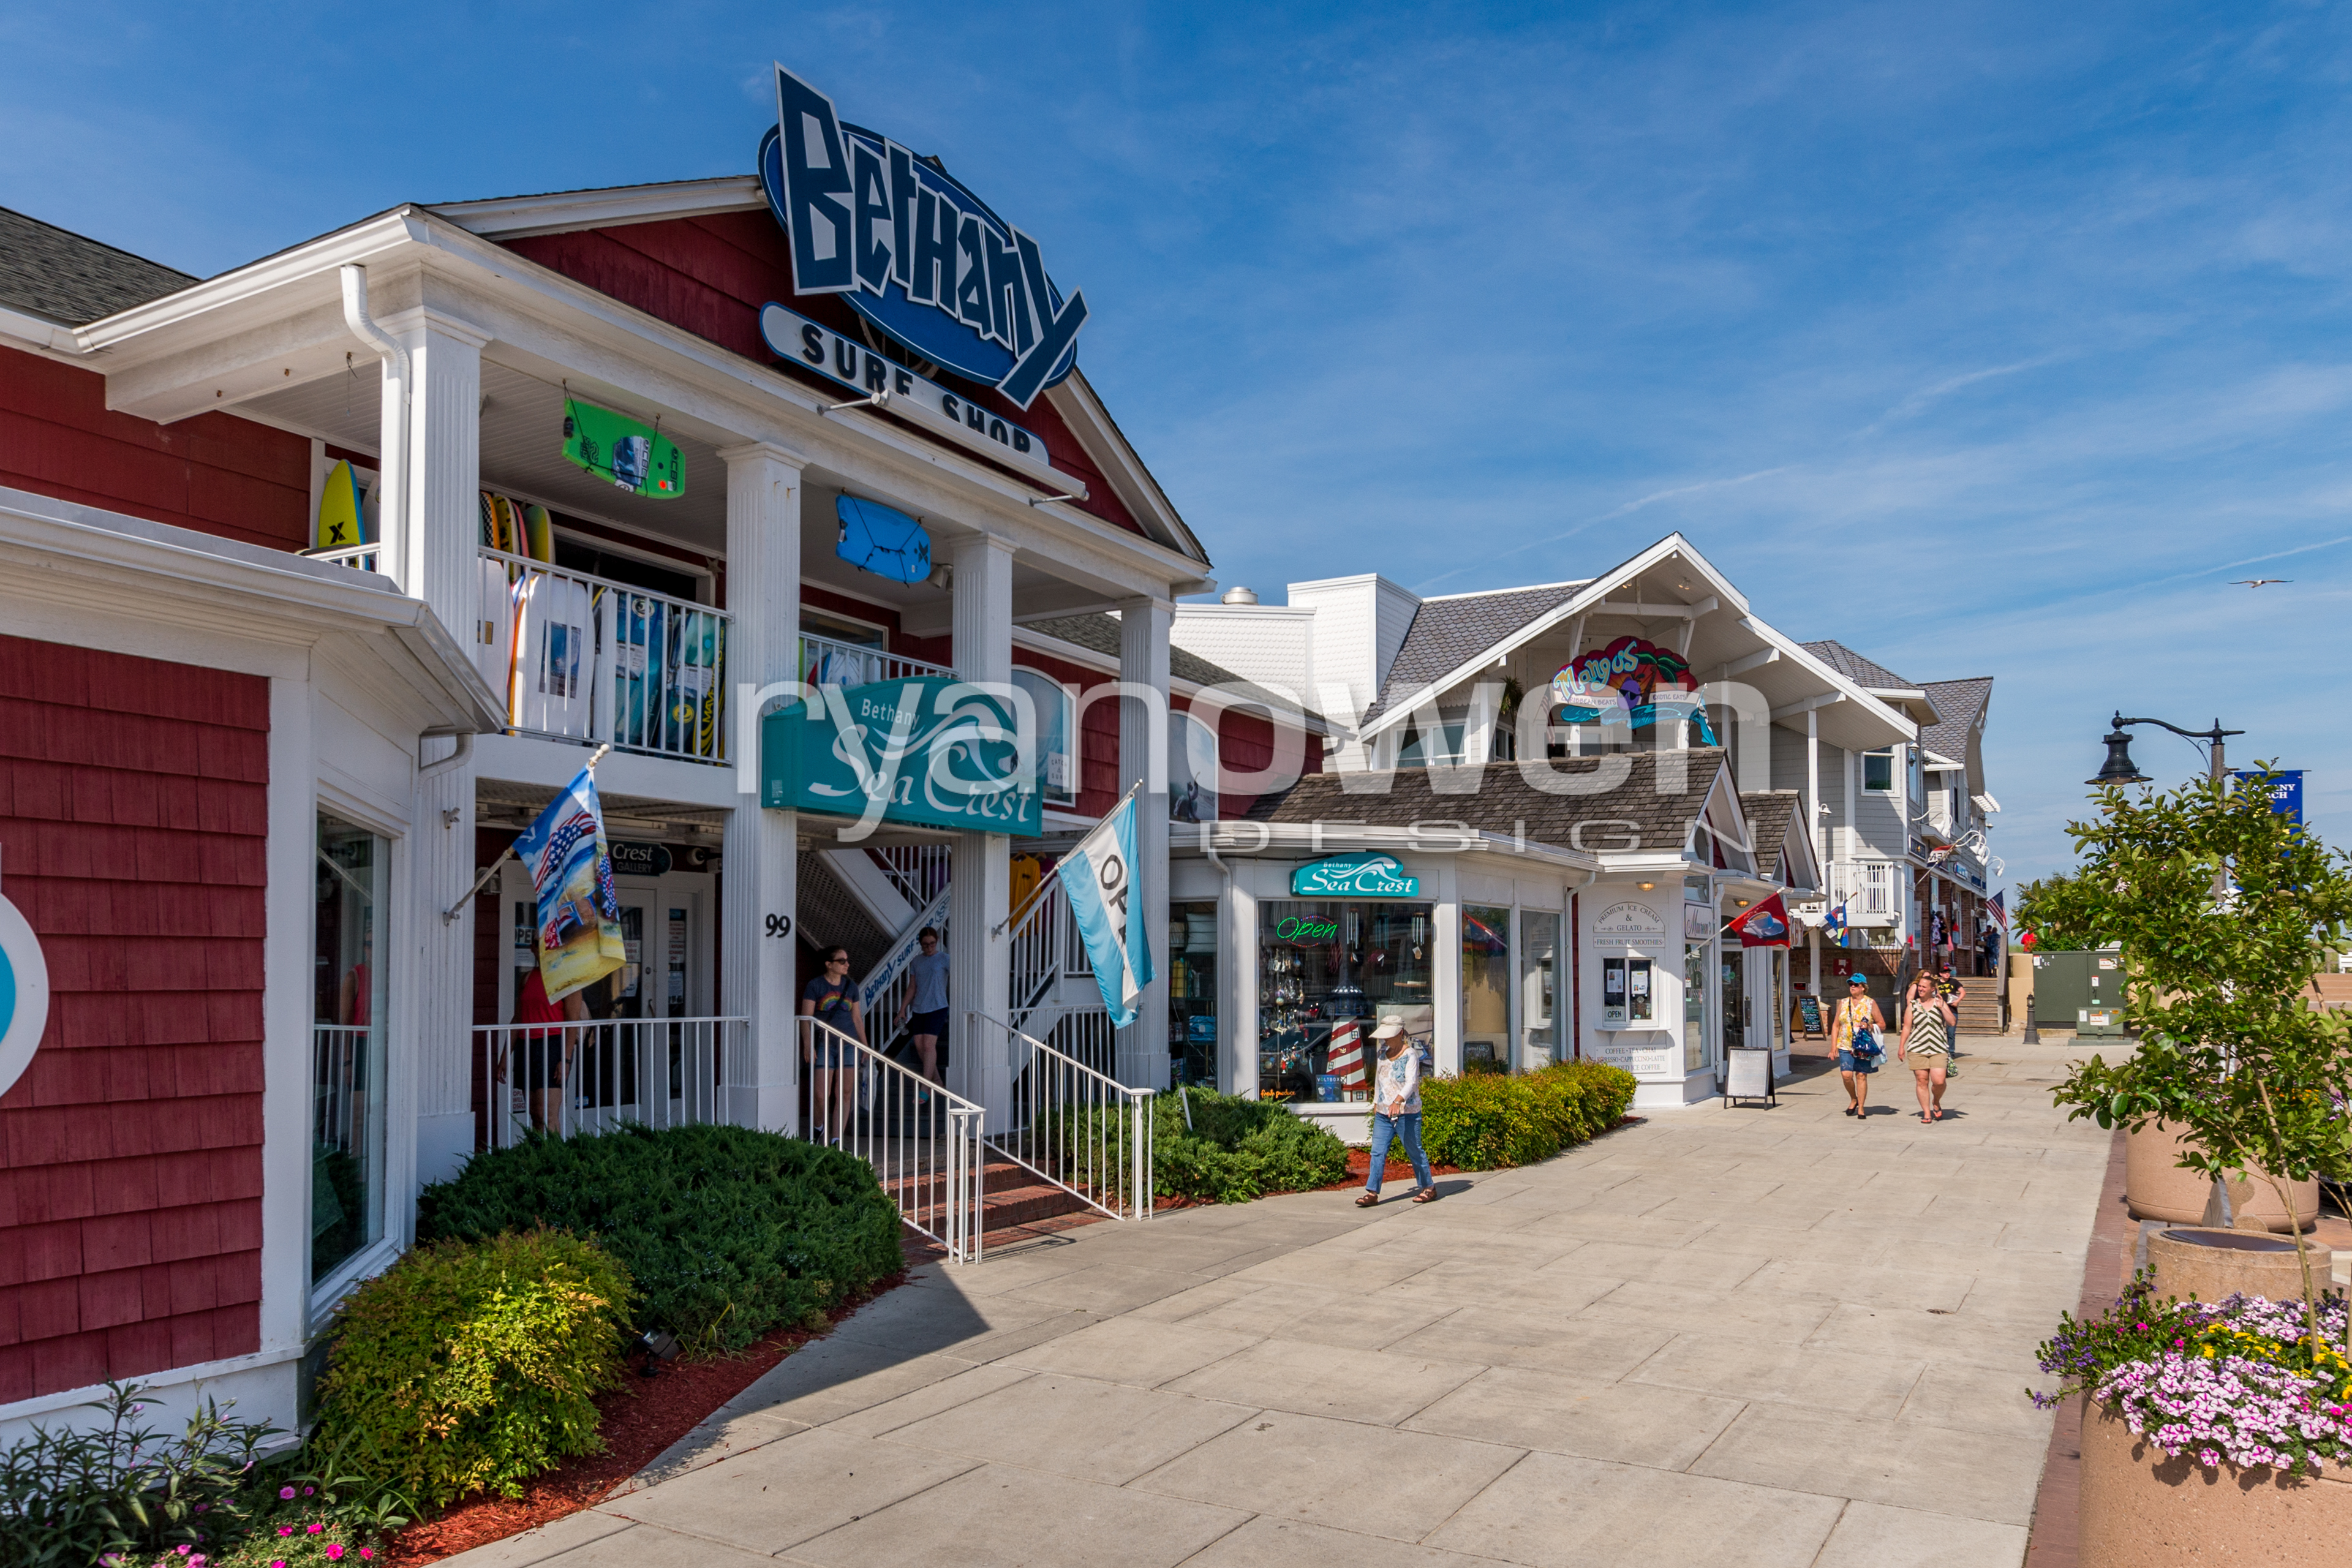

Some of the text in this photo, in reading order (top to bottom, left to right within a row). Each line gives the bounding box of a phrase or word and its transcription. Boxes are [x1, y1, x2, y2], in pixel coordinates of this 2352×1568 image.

[802, 323, 1031, 453] SURF SHOP
[1561, 696, 1596, 705] CRIBBEAN
[861, 698, 921, 731] Bethany
[808, 723, 1031, 823] Sea Crest
[612, 843, 654, 861] Crest
[617, 862, 652, 873] GALLERY
[1302, 869, 1351, 891] Sea
[1355, 870, 1412, 893] Crest
[766, 913, 791, 938] 99
[1598, 905, 1624, 924] PREMIUM
[1640, 907, 1660, 923] CREAM
[1277, 916, 1338, 941] Open
[897, 938, 915, 967] SURF
[1276, 1090, 1296, 1099] produce
